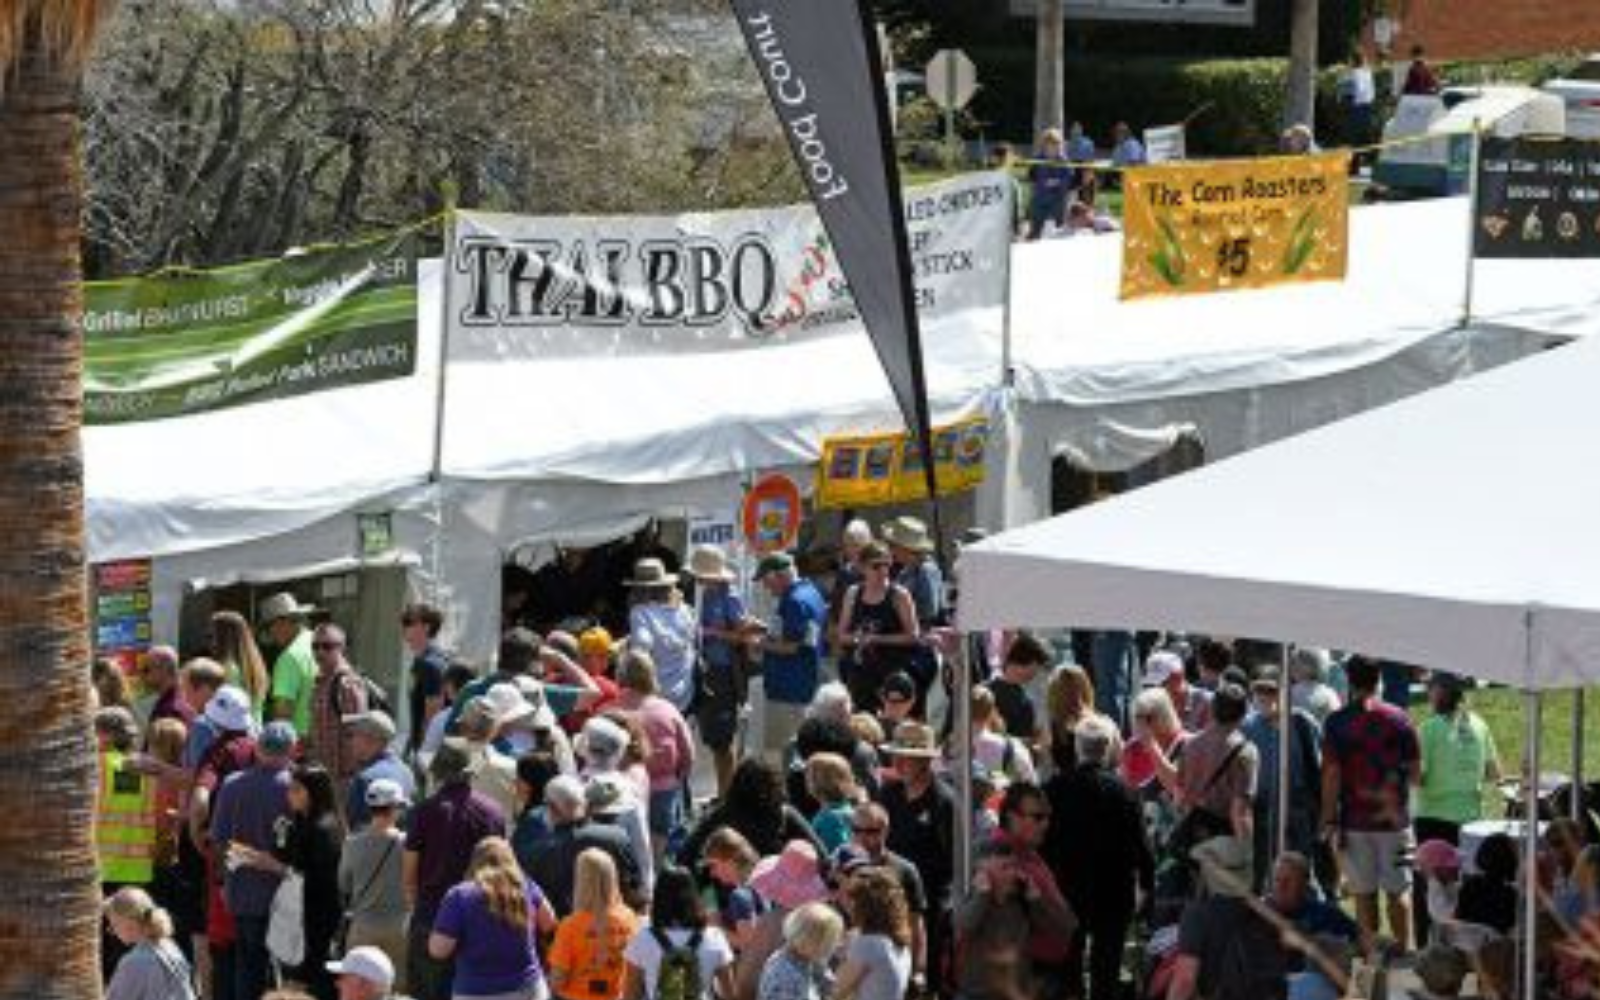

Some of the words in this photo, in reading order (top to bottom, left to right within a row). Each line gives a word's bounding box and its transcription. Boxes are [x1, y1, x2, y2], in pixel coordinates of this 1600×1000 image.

[1147, 182, 1183, 206] The
[1191, 180, 1235, 203] Corn
[1241, 175, 1327, 199] Roasters
[1216, 236, 1251, 277] $5
[457, 233, 632, 328] THAI
[638, 232, 779, 341] BBQ
[318, 343, 408, 378] SANDWICH
